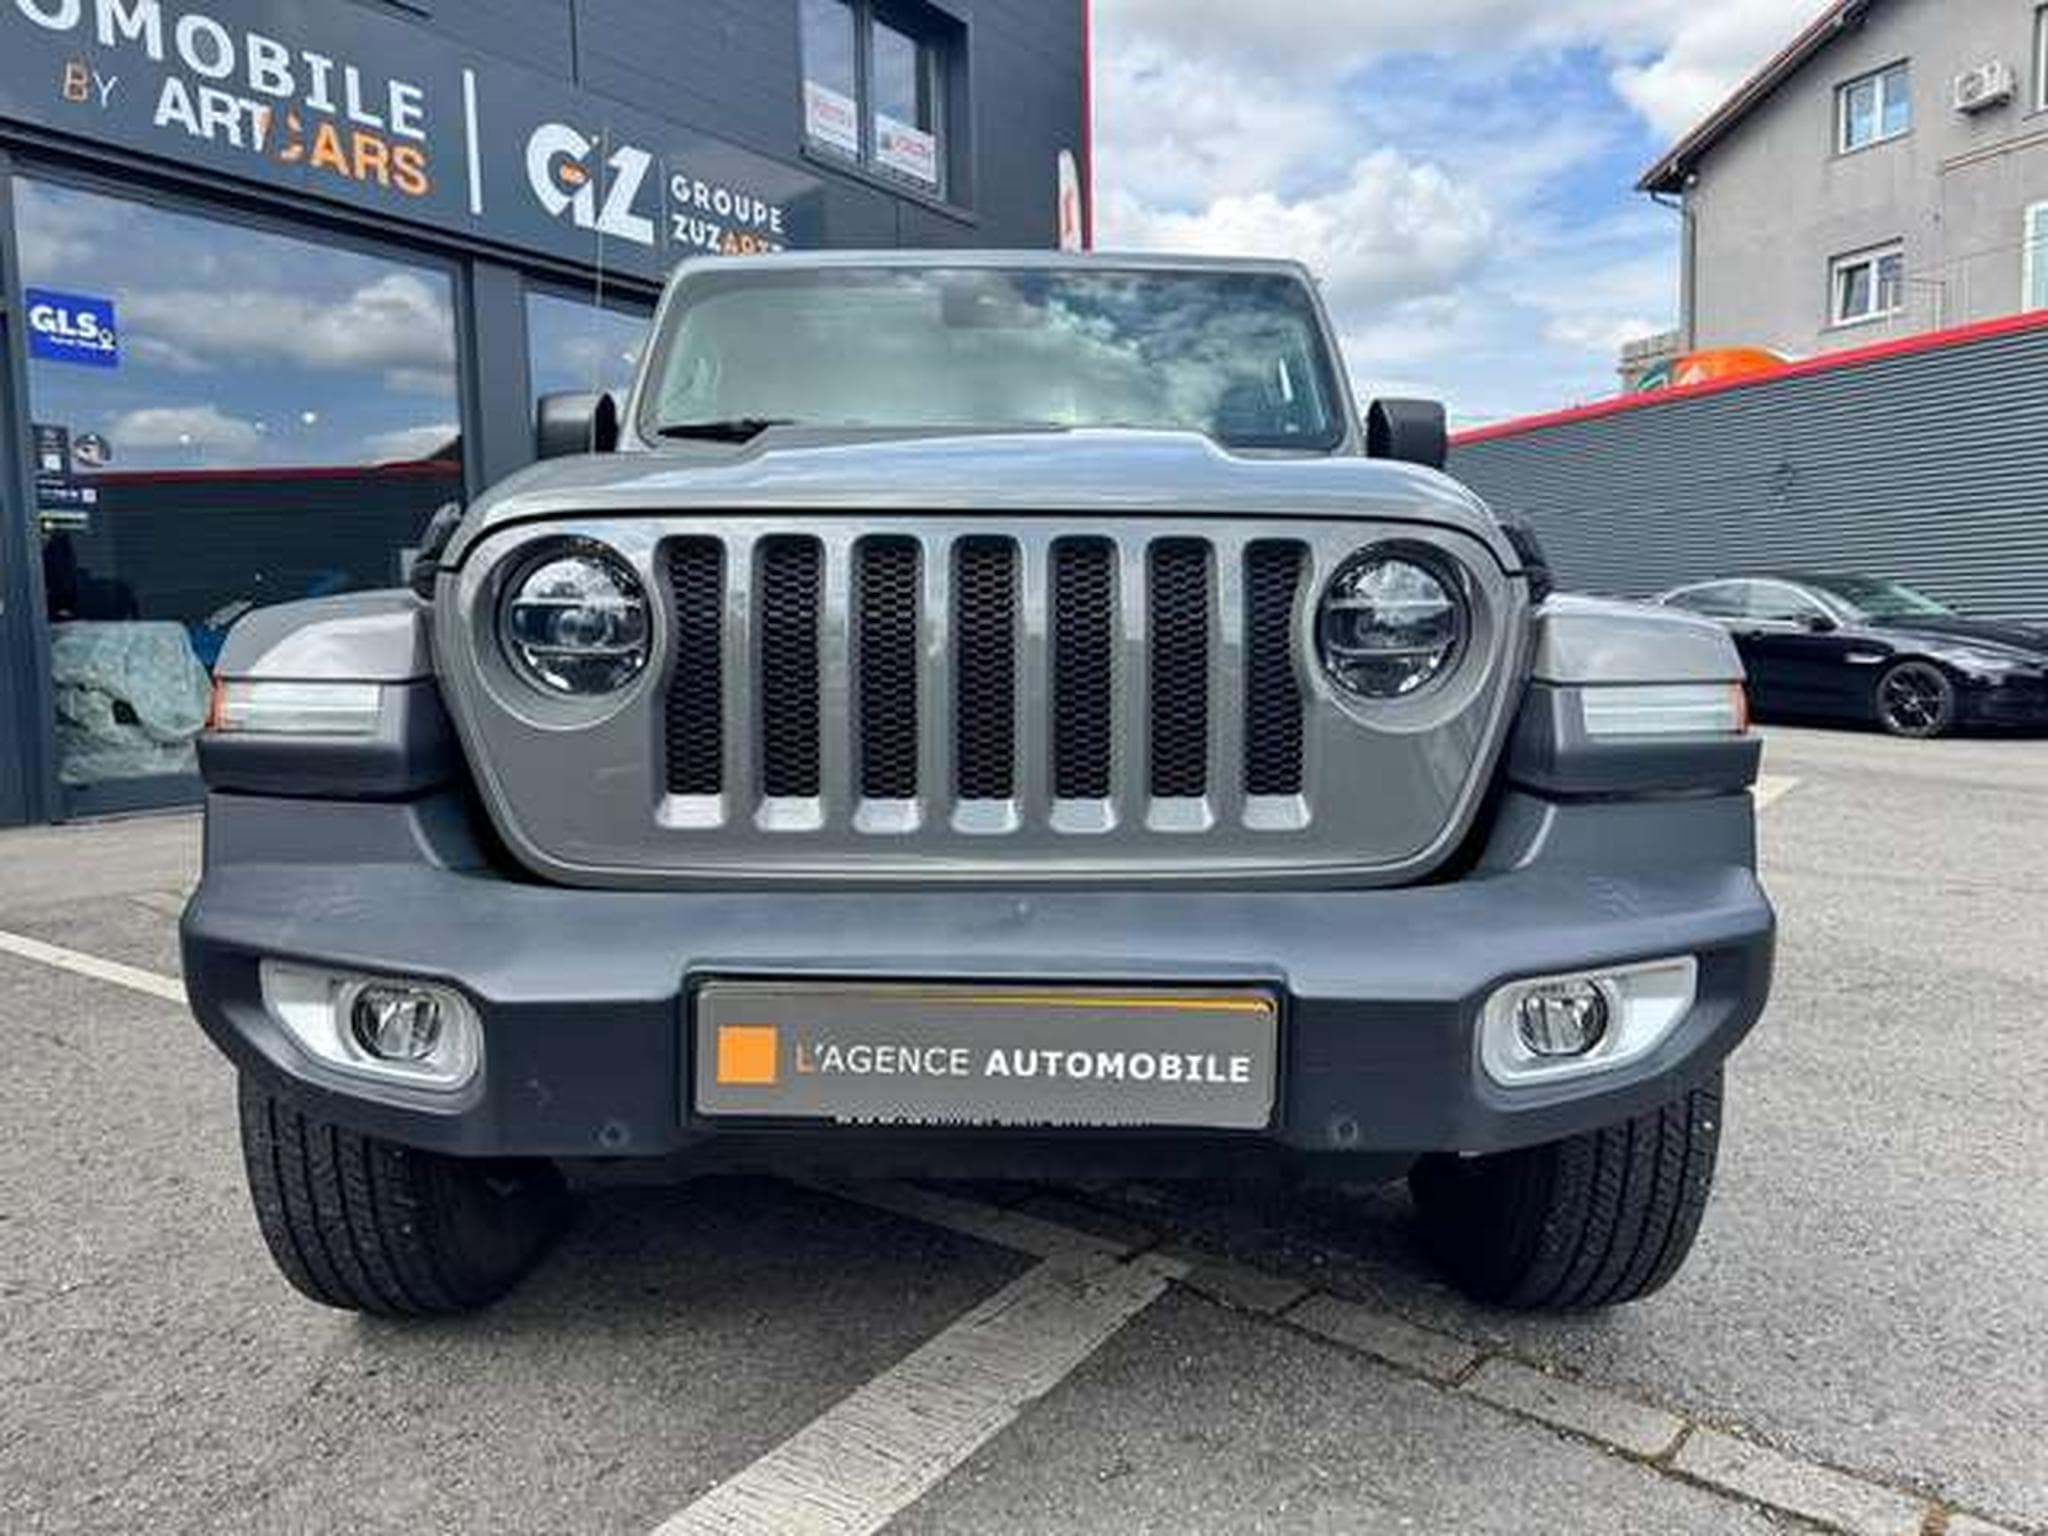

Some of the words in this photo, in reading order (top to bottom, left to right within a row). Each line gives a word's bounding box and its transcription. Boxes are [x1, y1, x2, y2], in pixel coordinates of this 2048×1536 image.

[62, 61, 118, 107] BY
[671, 174, 784, 234] GROUPE
[29, 304, 99, 340] GLS
[796, 1042, 970, 1076] L'AGENCE
[984, 1048, 1251, 1083] AUTOMOBILE
